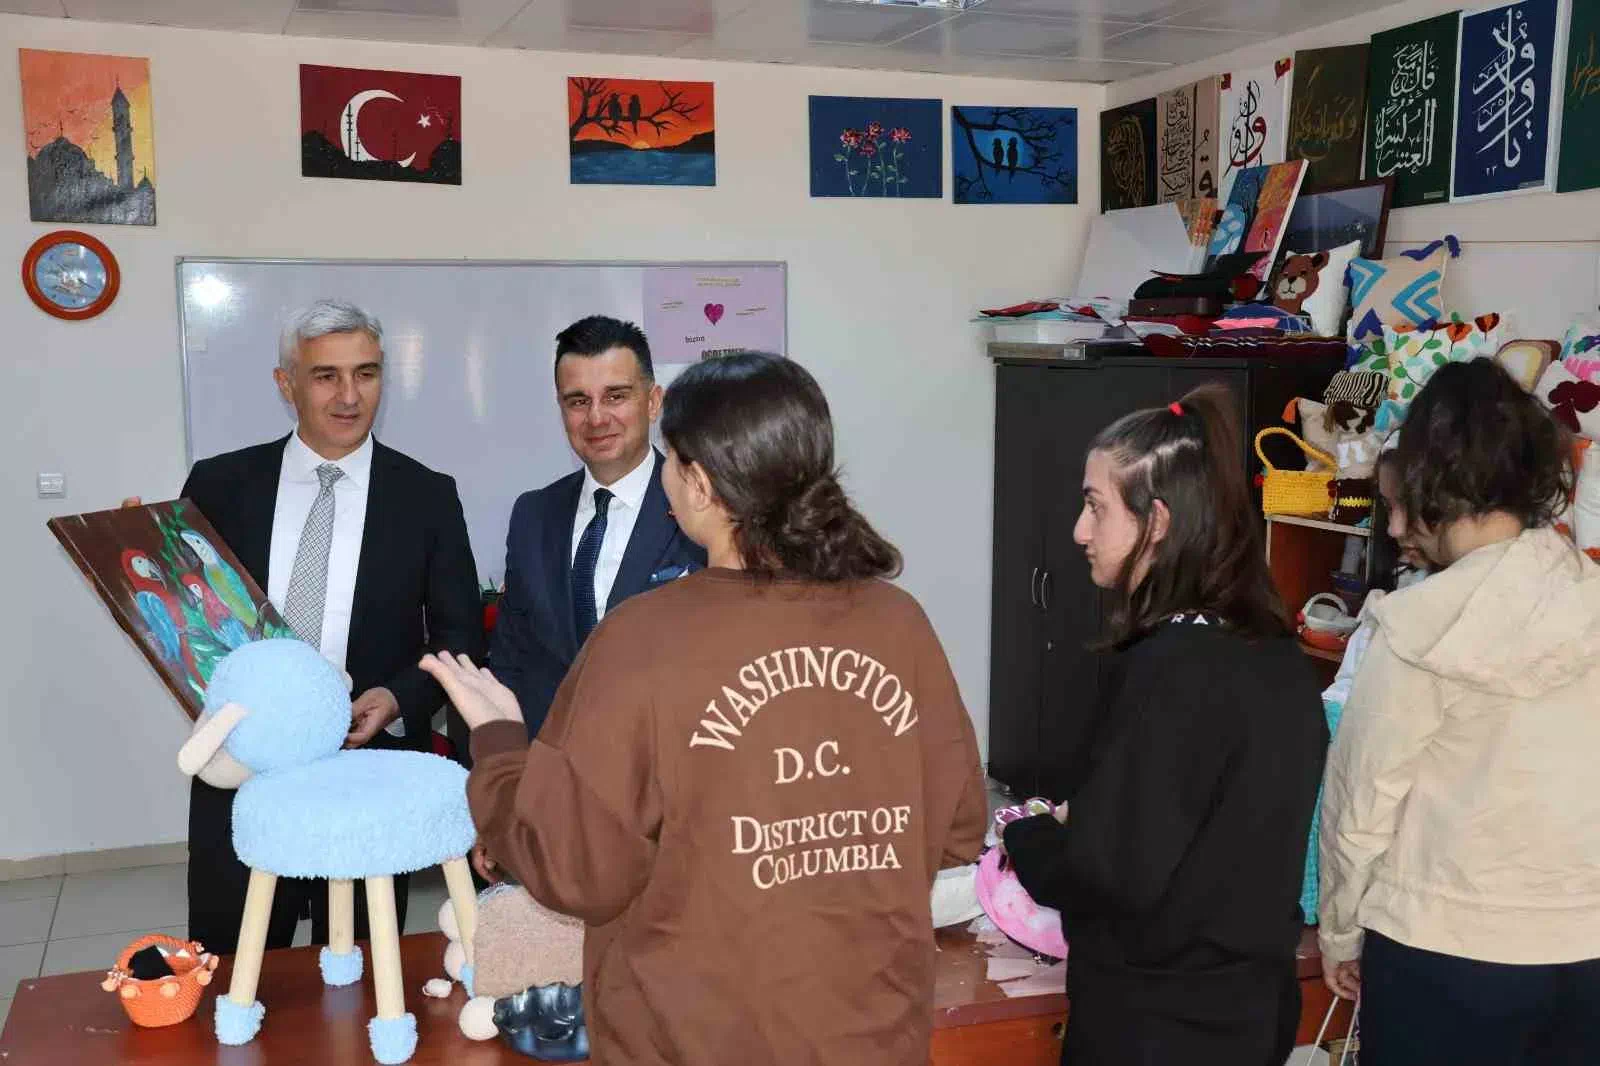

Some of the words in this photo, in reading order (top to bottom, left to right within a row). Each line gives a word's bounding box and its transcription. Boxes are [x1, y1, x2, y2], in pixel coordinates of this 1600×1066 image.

[689, 646, 919, 750] WASHINGTON
[774, 740, 850, 784] D.C.
[730, 810, 868, 854] DISTRICT
[871, 806, 911, 835] OF
[752, 842, 902, 889] COLUMBIA
